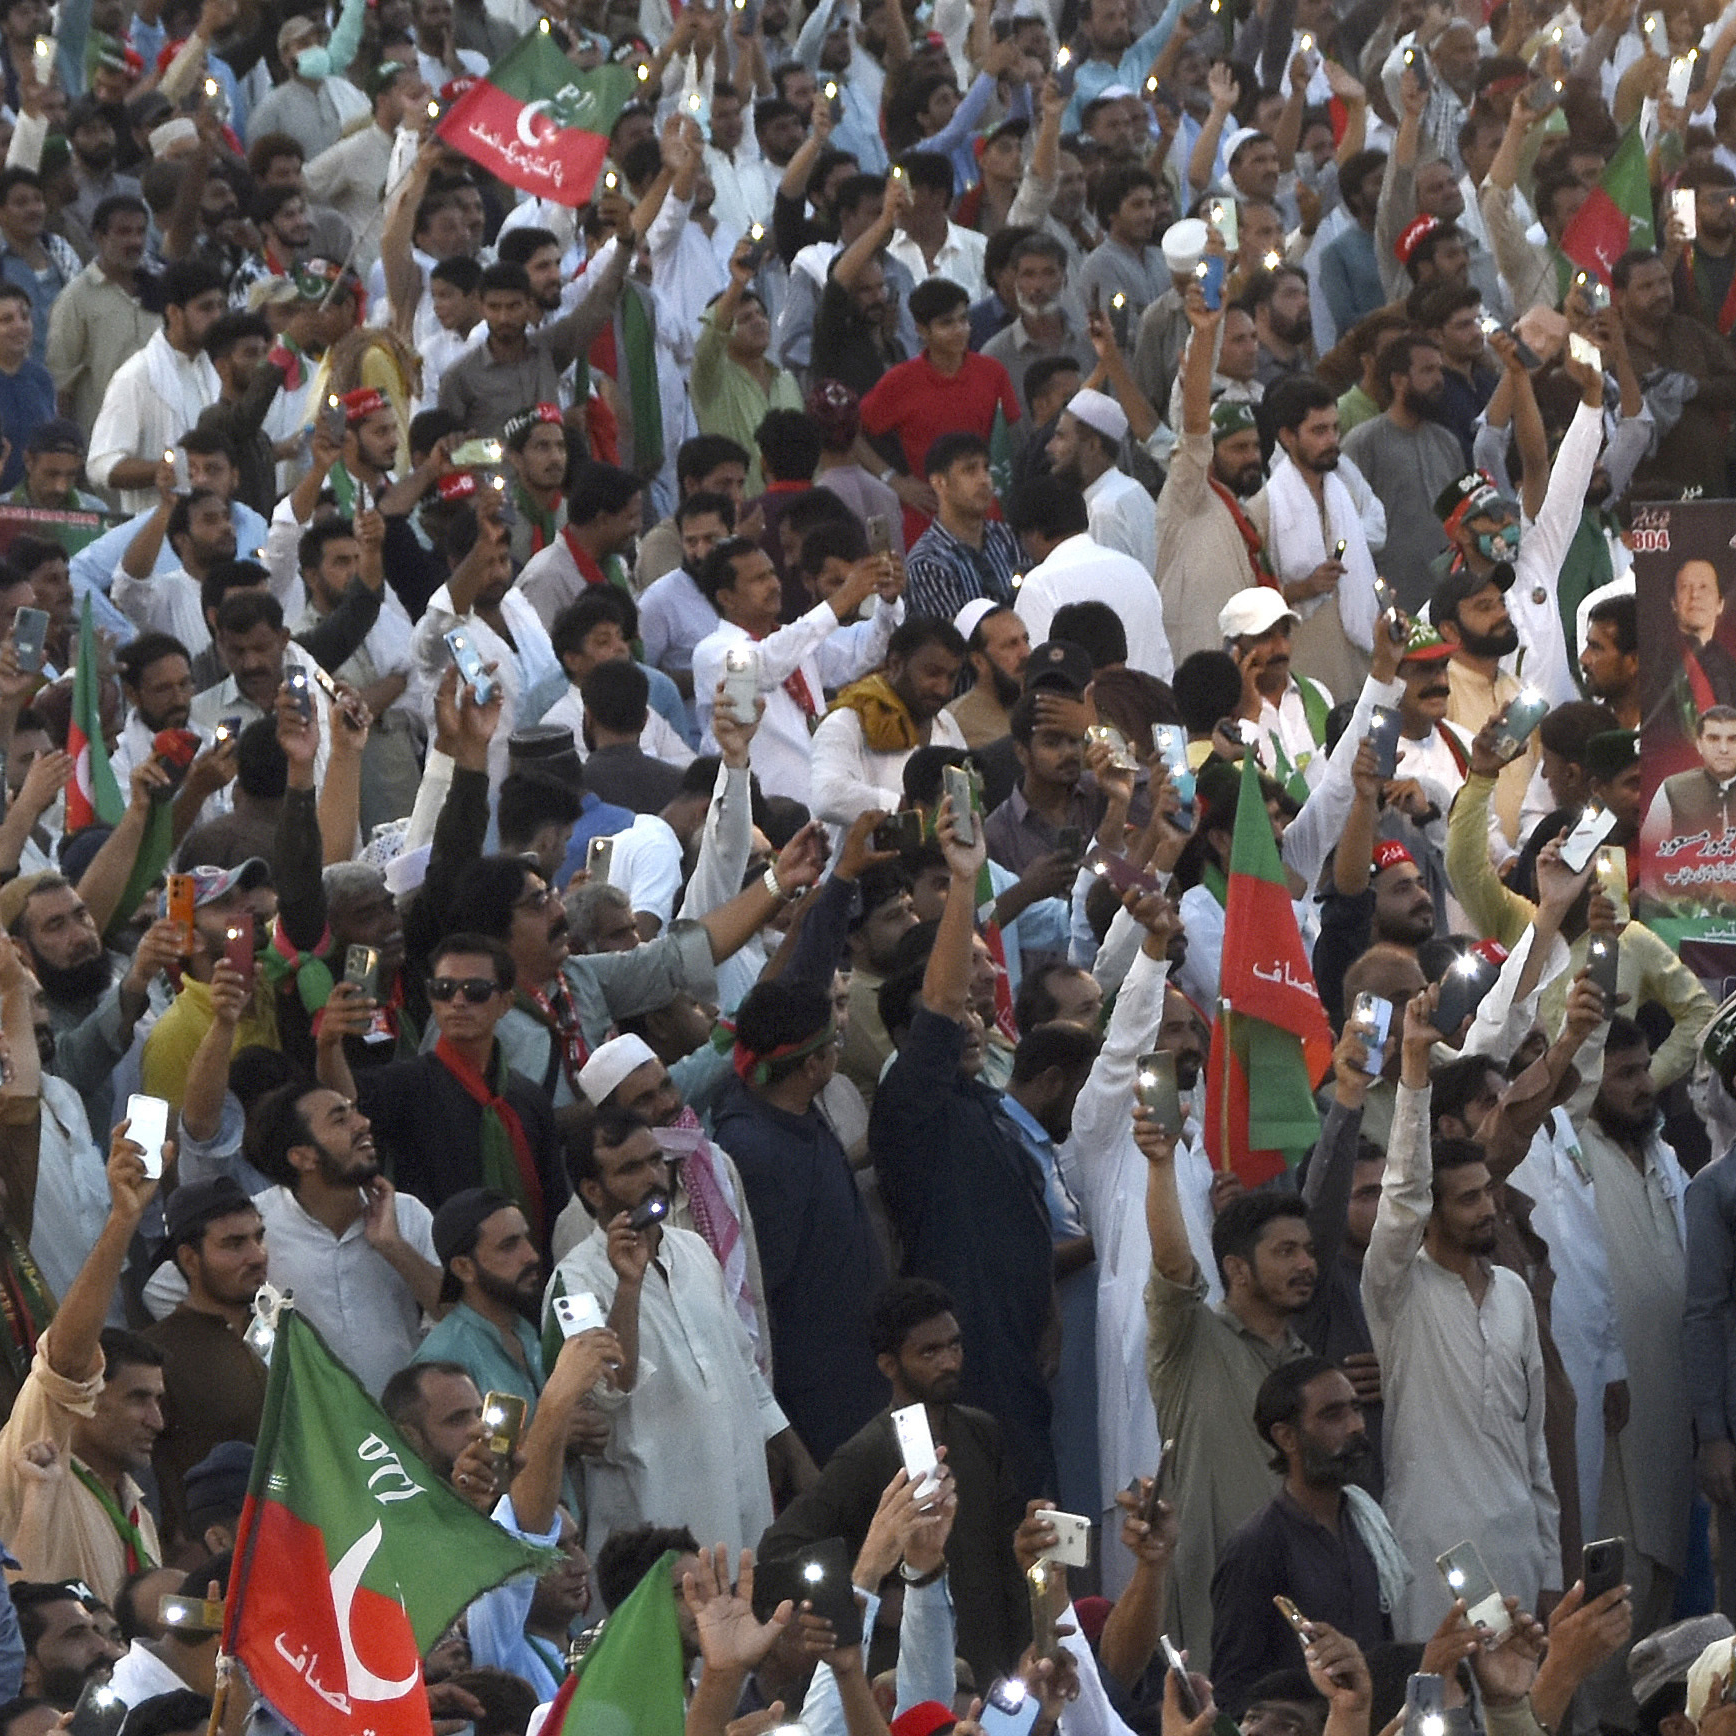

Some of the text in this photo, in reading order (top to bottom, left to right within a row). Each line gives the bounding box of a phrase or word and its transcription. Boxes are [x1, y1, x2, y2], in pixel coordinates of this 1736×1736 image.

[1631, 530, 1670, 551] 804
[1252, 960, 1320, 999] صاف
[358, 1432, 428, 1506] PTI
[275, 1632, 353, 1715] صاف
